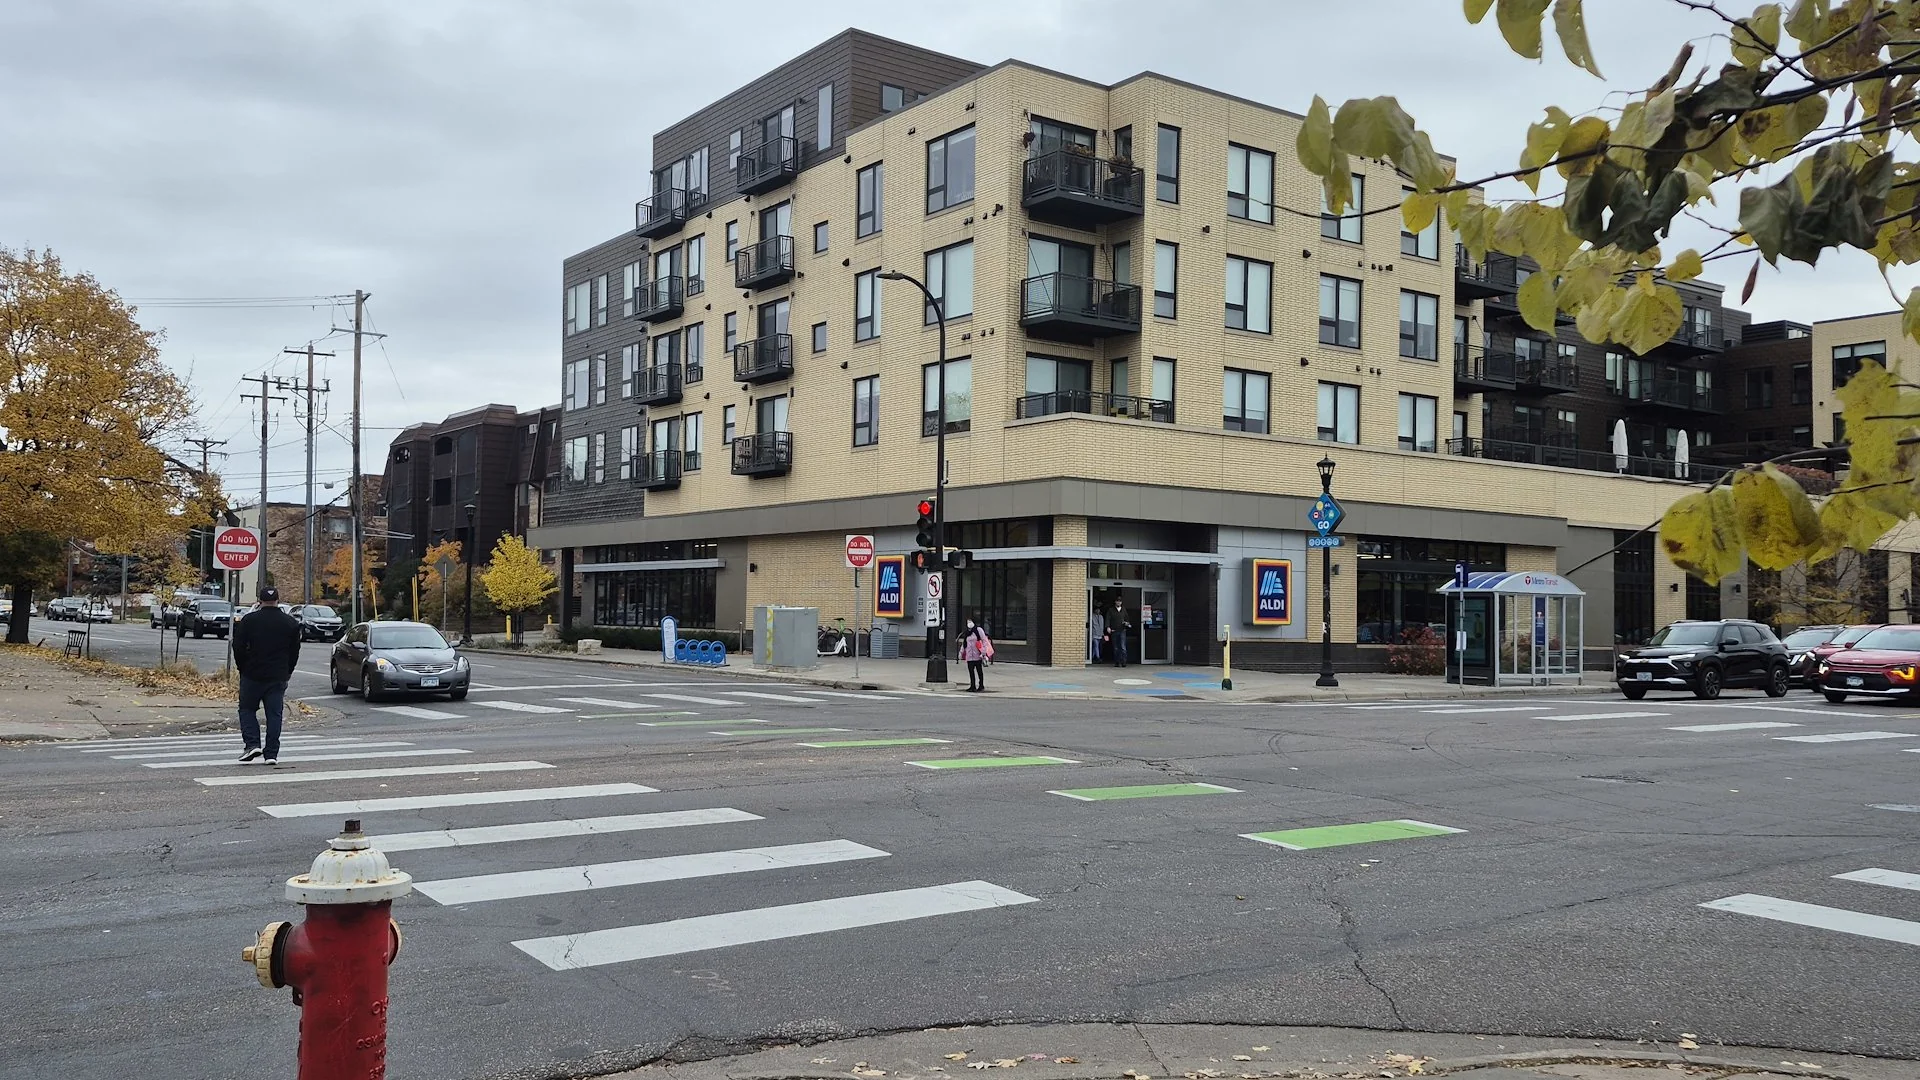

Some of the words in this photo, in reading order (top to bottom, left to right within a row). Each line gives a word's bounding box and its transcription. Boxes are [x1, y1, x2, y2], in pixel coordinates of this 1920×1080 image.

[1318, 521, 1329, 529] GO
[224, 553, 249, 561] ENTER
[1532, 577, 1545, 585] Metro
[880, 593, 898, 603] ALDI
[1260, 598, 1284, 610] ALDI
